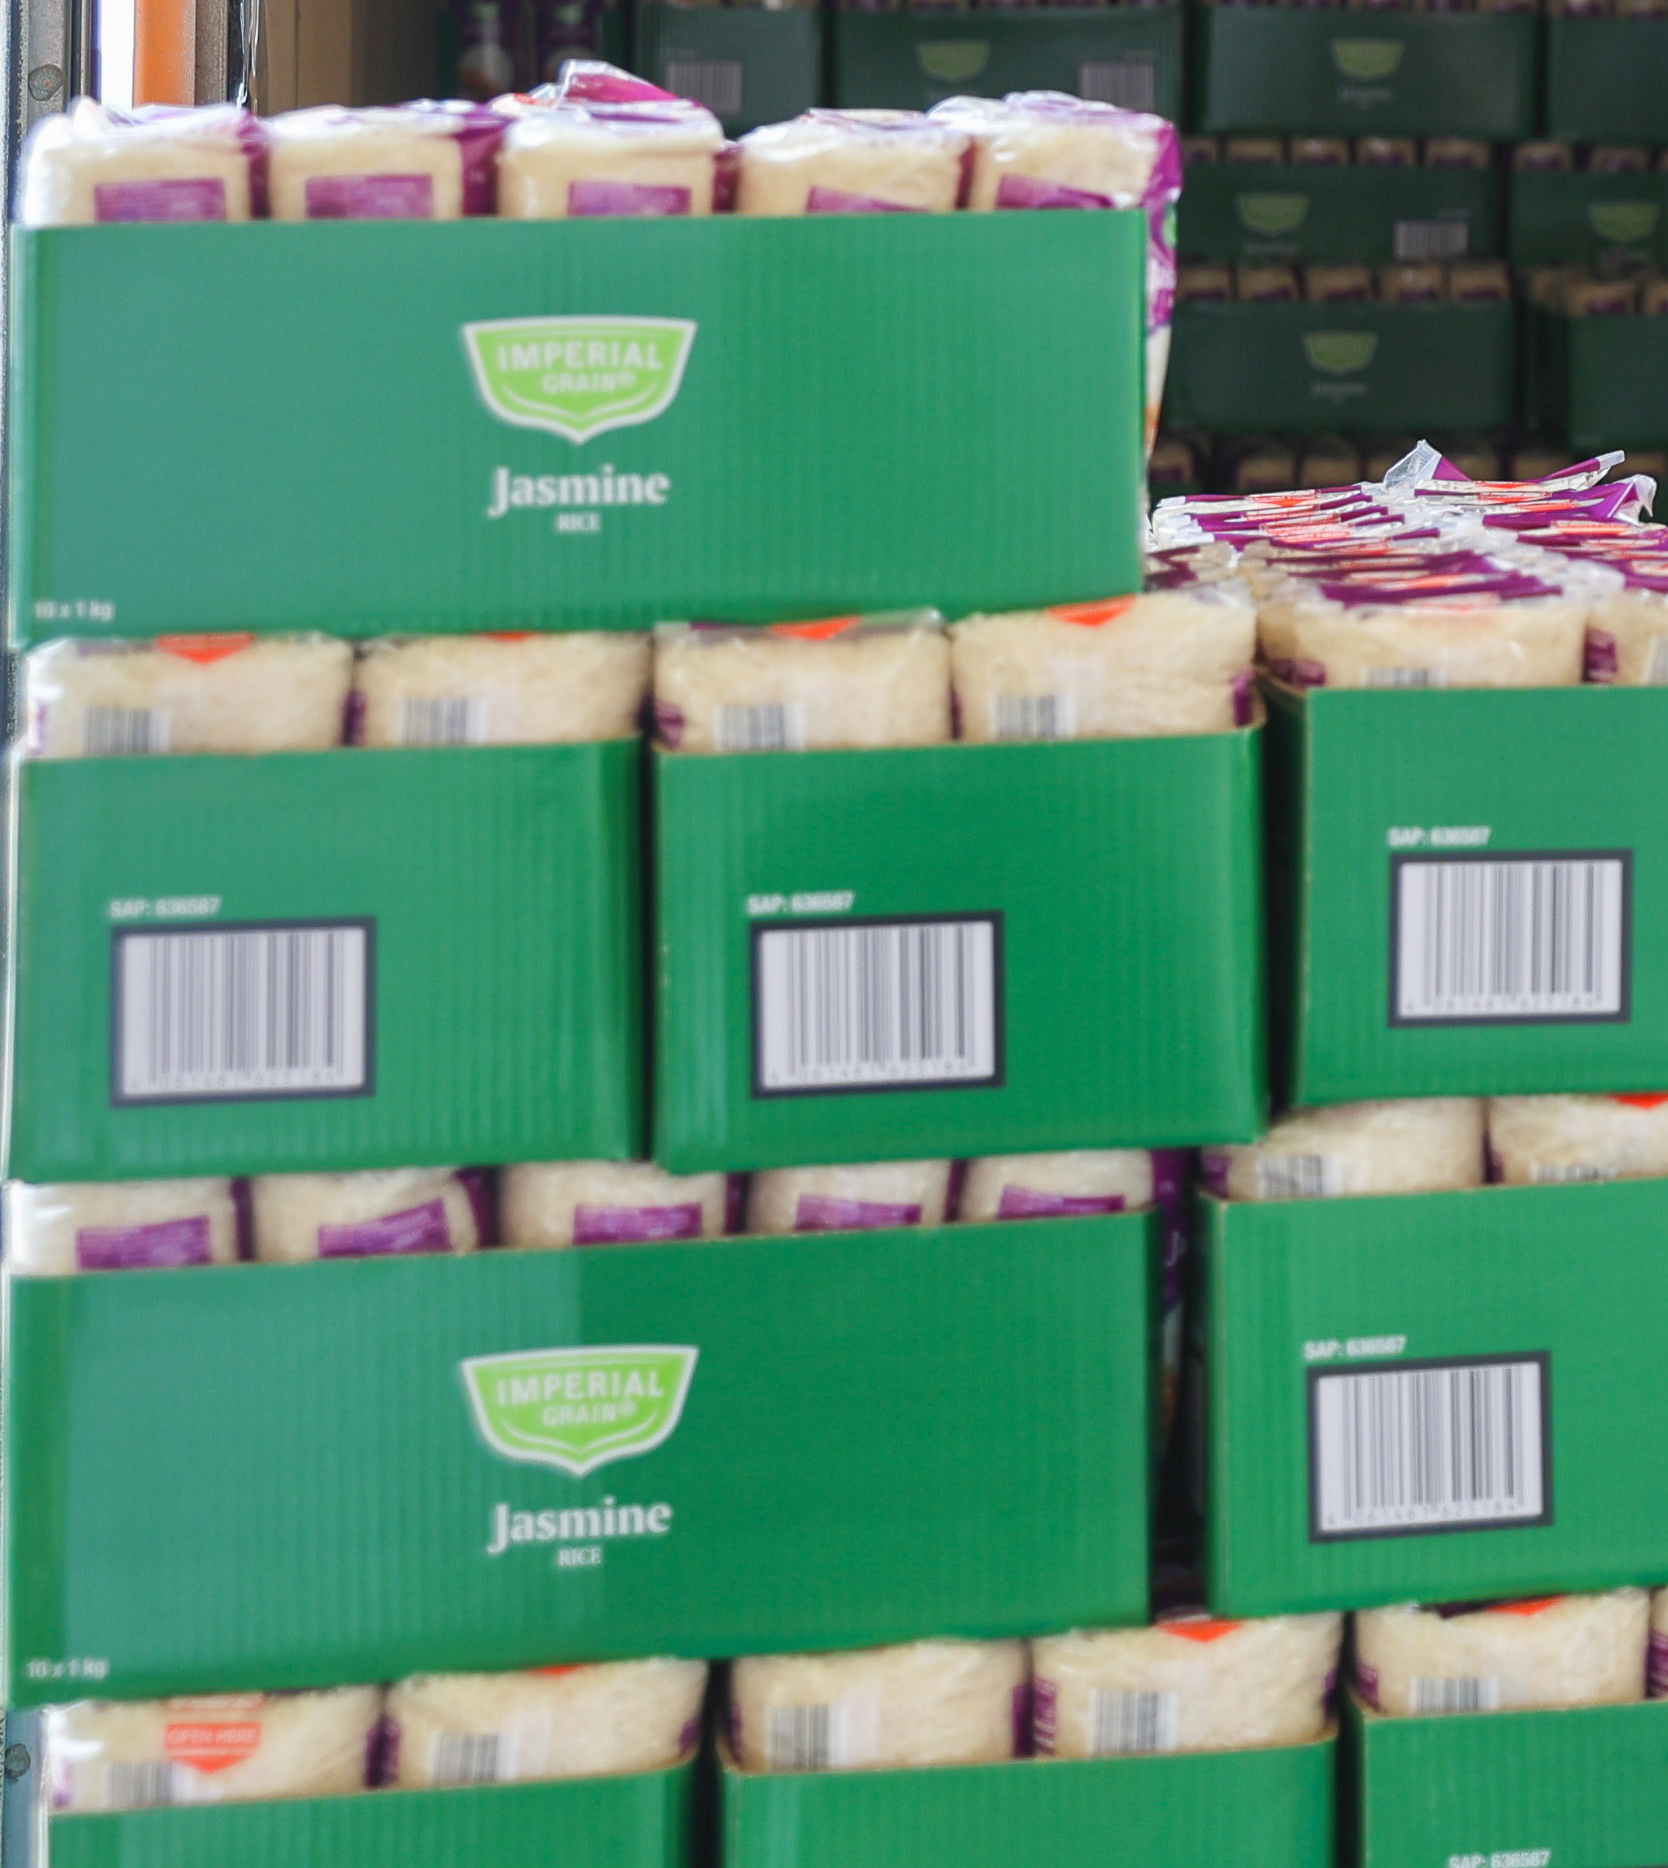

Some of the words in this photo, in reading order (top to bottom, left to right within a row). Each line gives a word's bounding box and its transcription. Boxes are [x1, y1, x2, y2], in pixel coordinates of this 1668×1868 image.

[497, 340, 663, 372] IMPERIAL
[486, 463, 671, 520] Jasmine
[556, 512, 601, 532] RICE
[109, 898, 149, 919] SAP:
[747, 892, 787, 916] SAP:
[1303, 1339, 1342, 1361] SAP:
[496, 1369, 665, 1408] IMPERIAL
[486, 1494, 673, 1556] Jasmine
[558, 1545, 603, 1568] RICE
